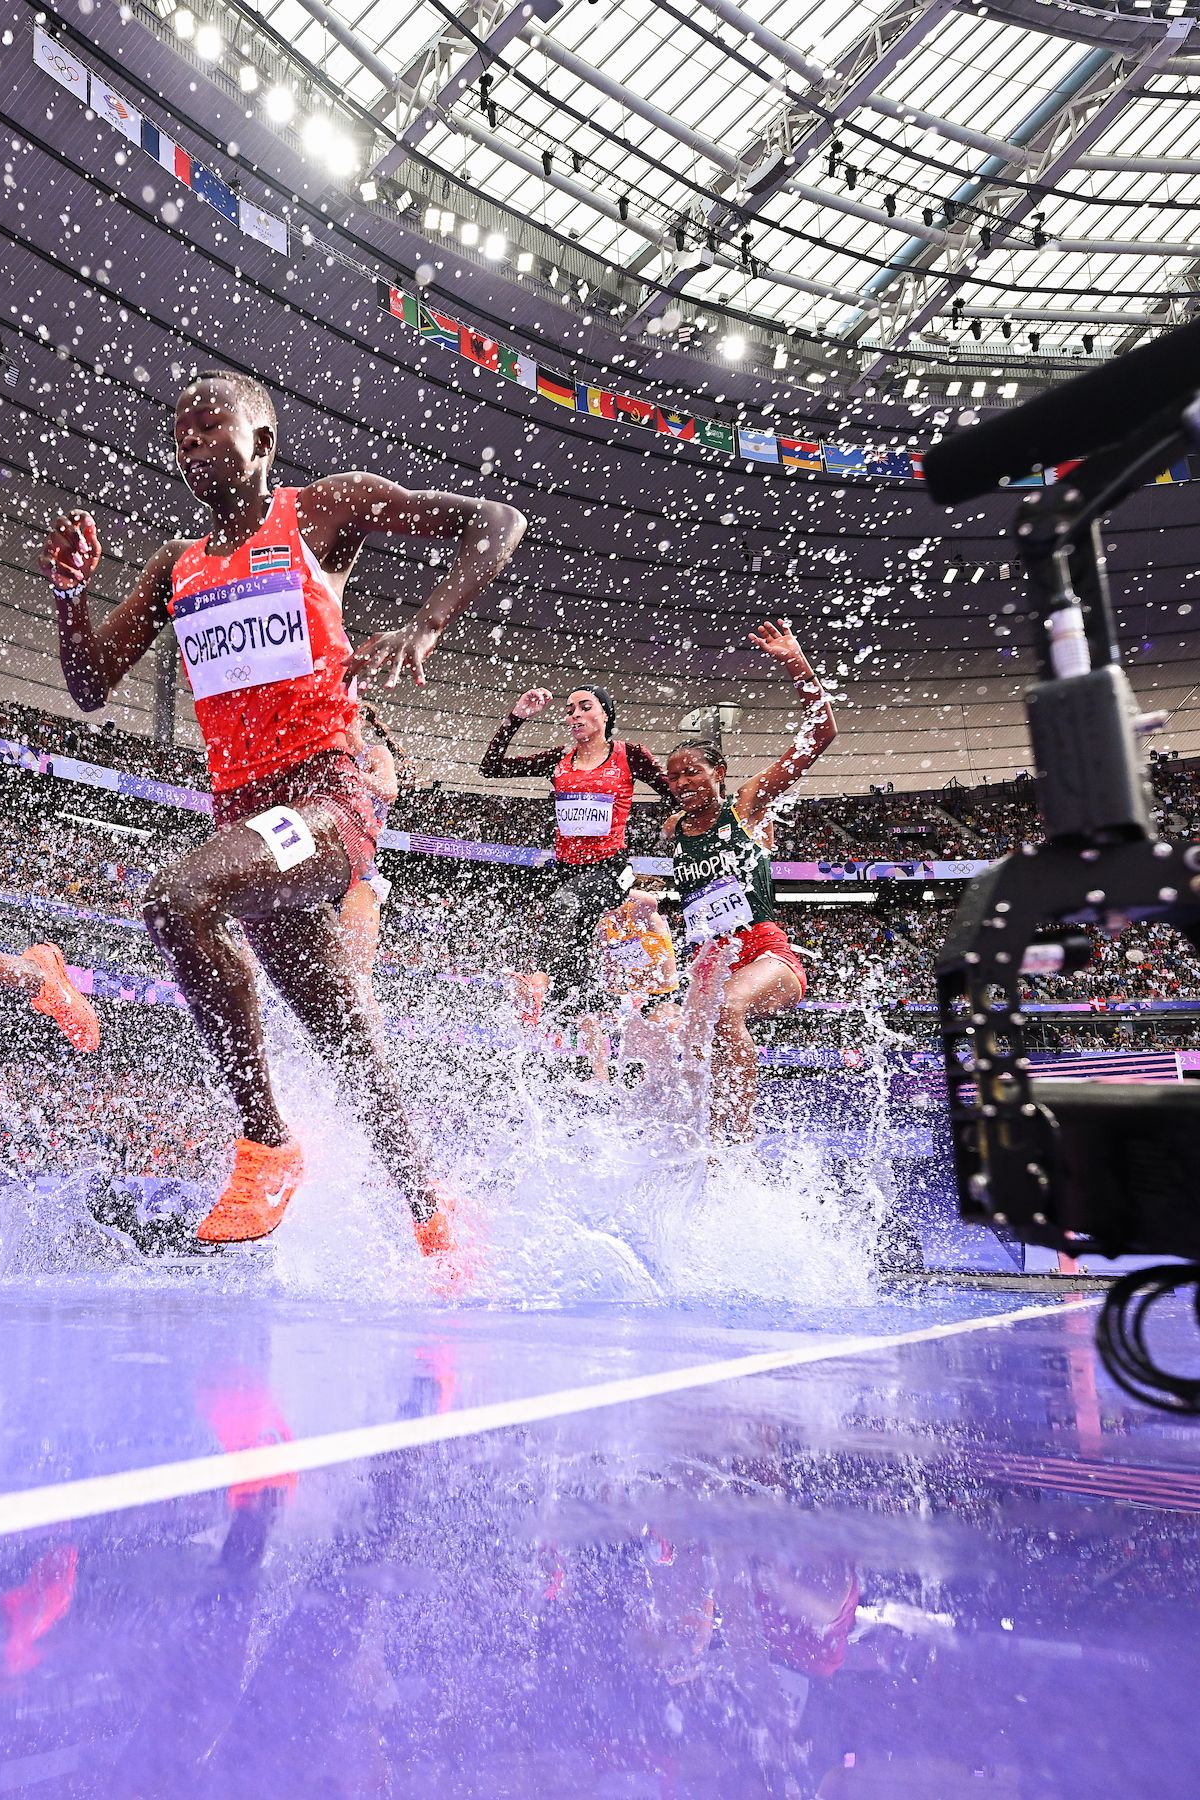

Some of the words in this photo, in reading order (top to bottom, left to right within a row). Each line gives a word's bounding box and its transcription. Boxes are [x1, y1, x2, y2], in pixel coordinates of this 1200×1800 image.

[230, 581, 261, 598] 2024
[184, 610, 304, 666] CHEROTICH
[271, 816, 302, 850] 11
[686, 892, 744, 930] MLETA
